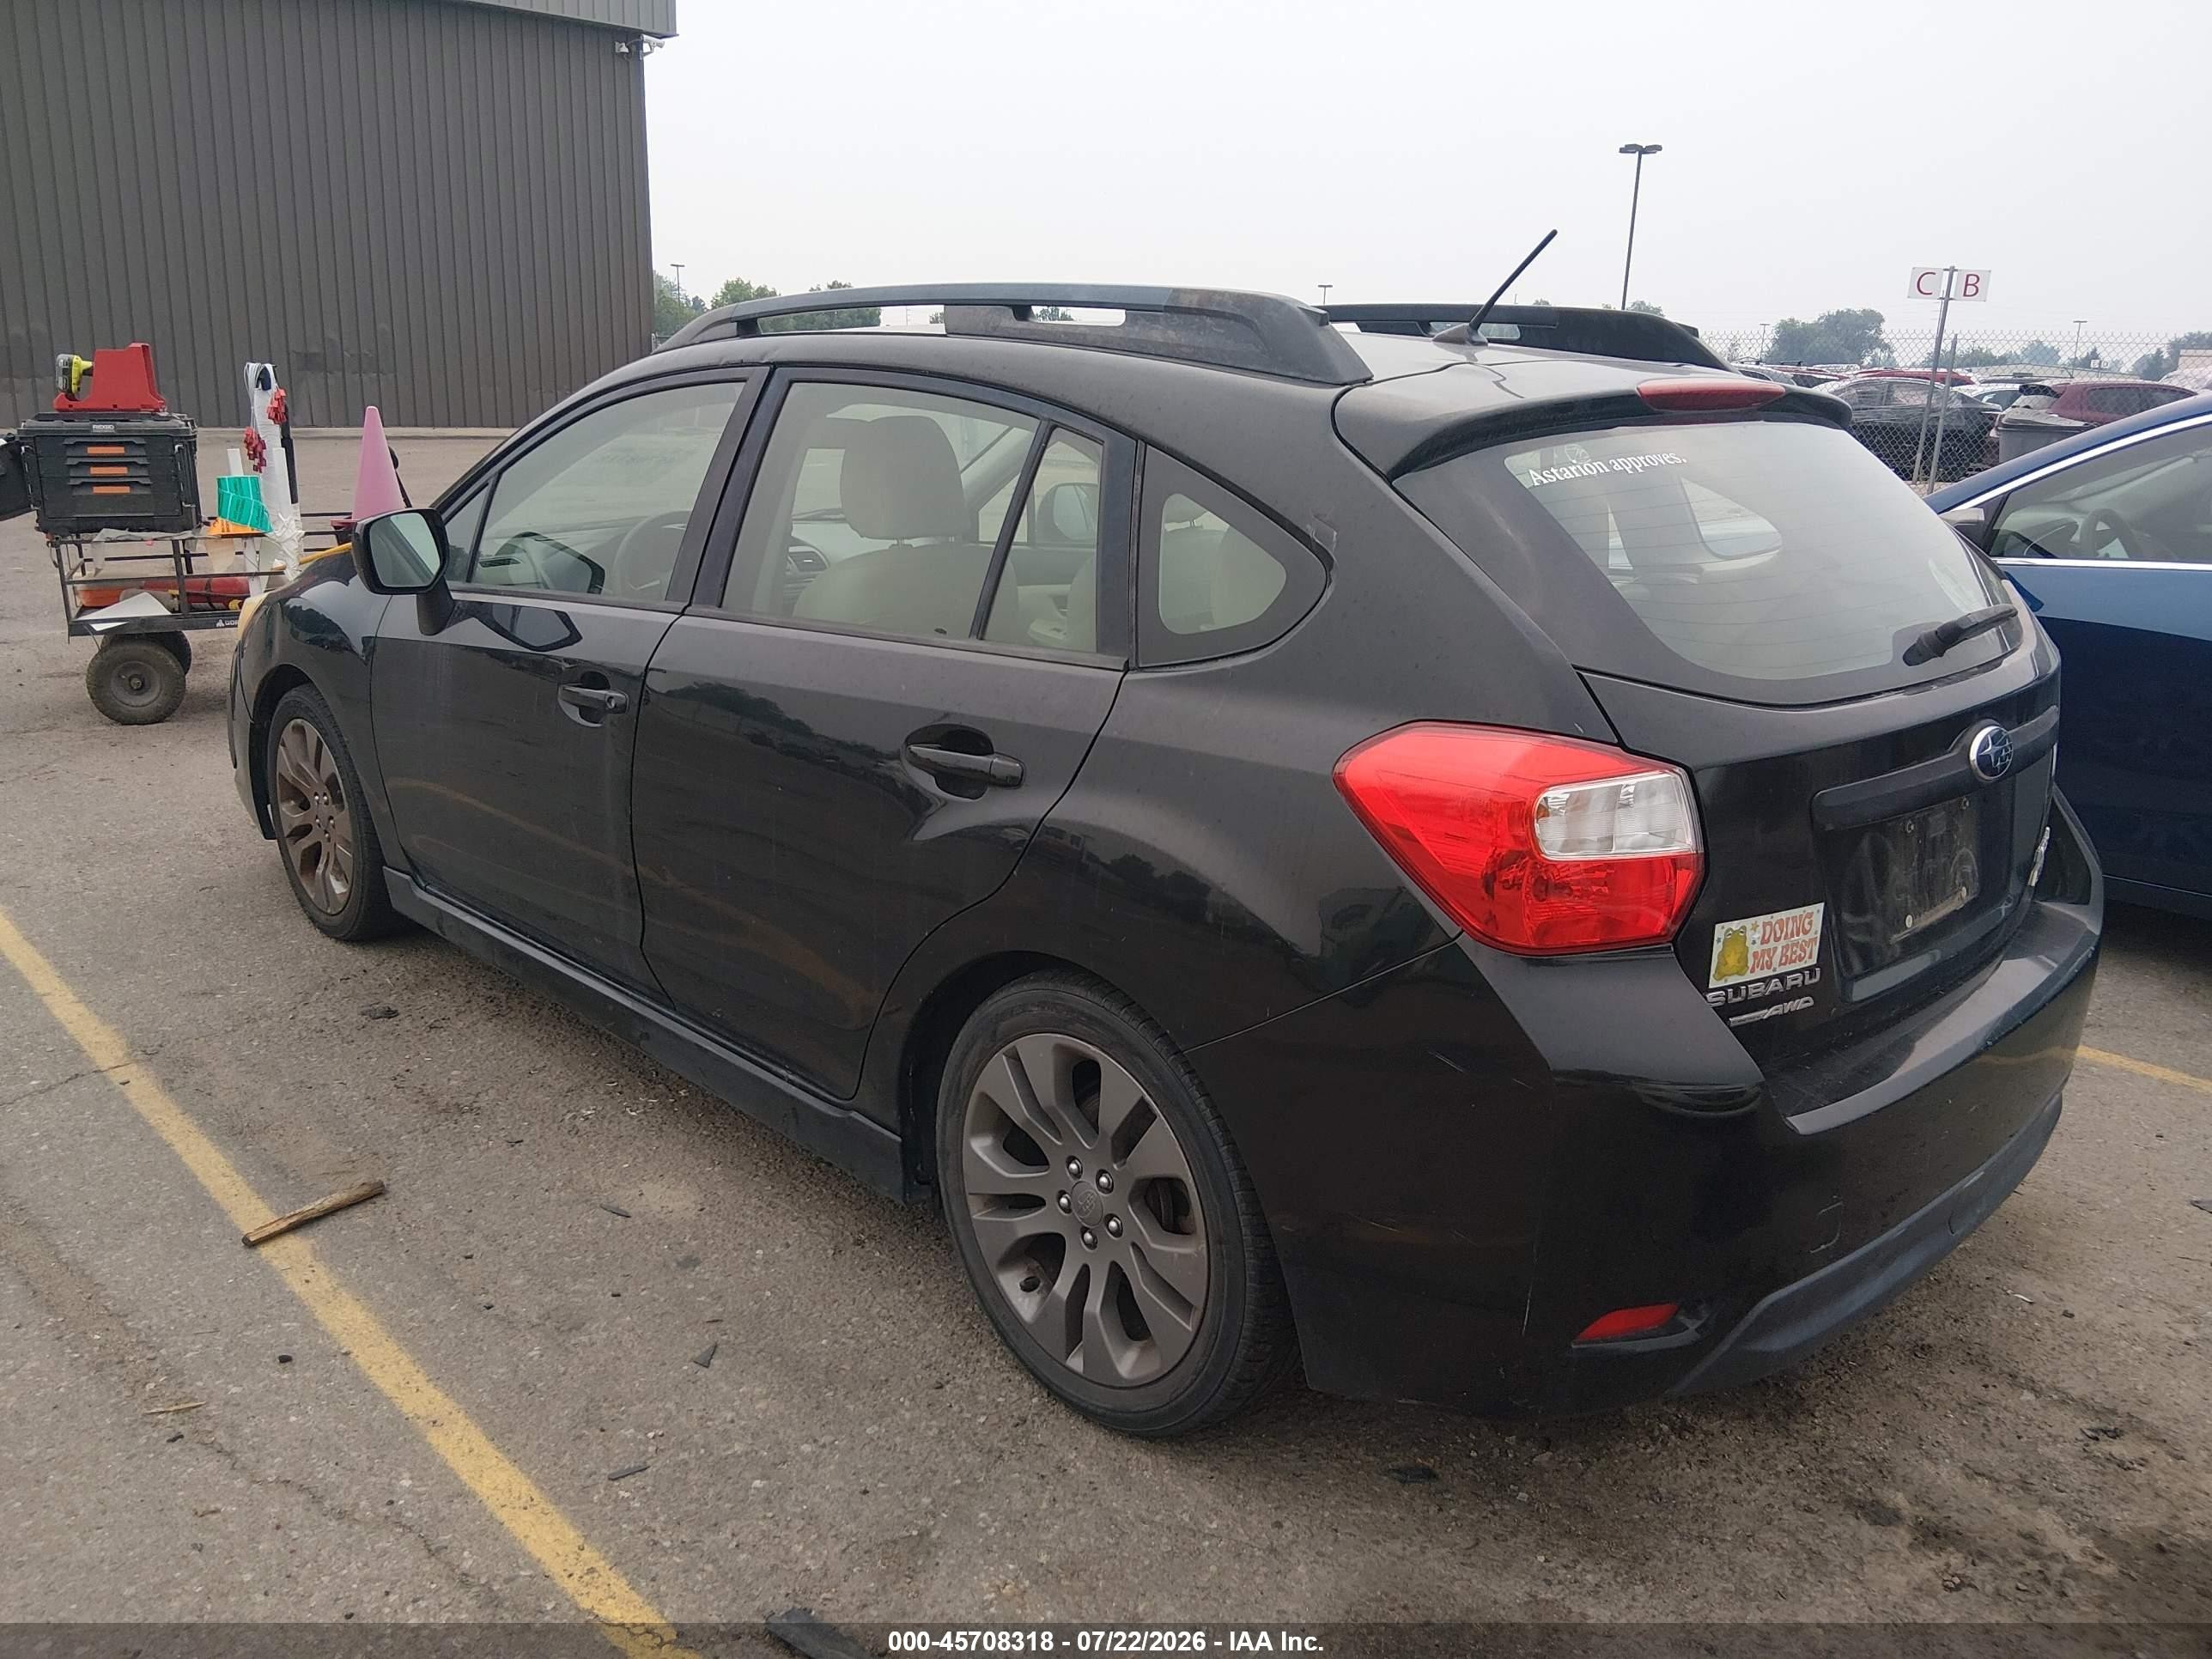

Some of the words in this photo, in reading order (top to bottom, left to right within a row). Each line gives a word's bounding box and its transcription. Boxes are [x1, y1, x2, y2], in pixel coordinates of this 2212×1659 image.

[1917, 271, 1936, 295] C
[1963, 273, 1980, 297] B
[1528, 459, 1610, 486] Astarion
[1609, 453, 1687, 474] approves.
[1760, 912, 1814, 945] DOING
[1750, 946, 1778, 973] MY
[1779, 937, 1817, 966] BEST
[1706, 968, 1821, 1008] SUBARU
[1764, 996, 1814, 1019] AWD
